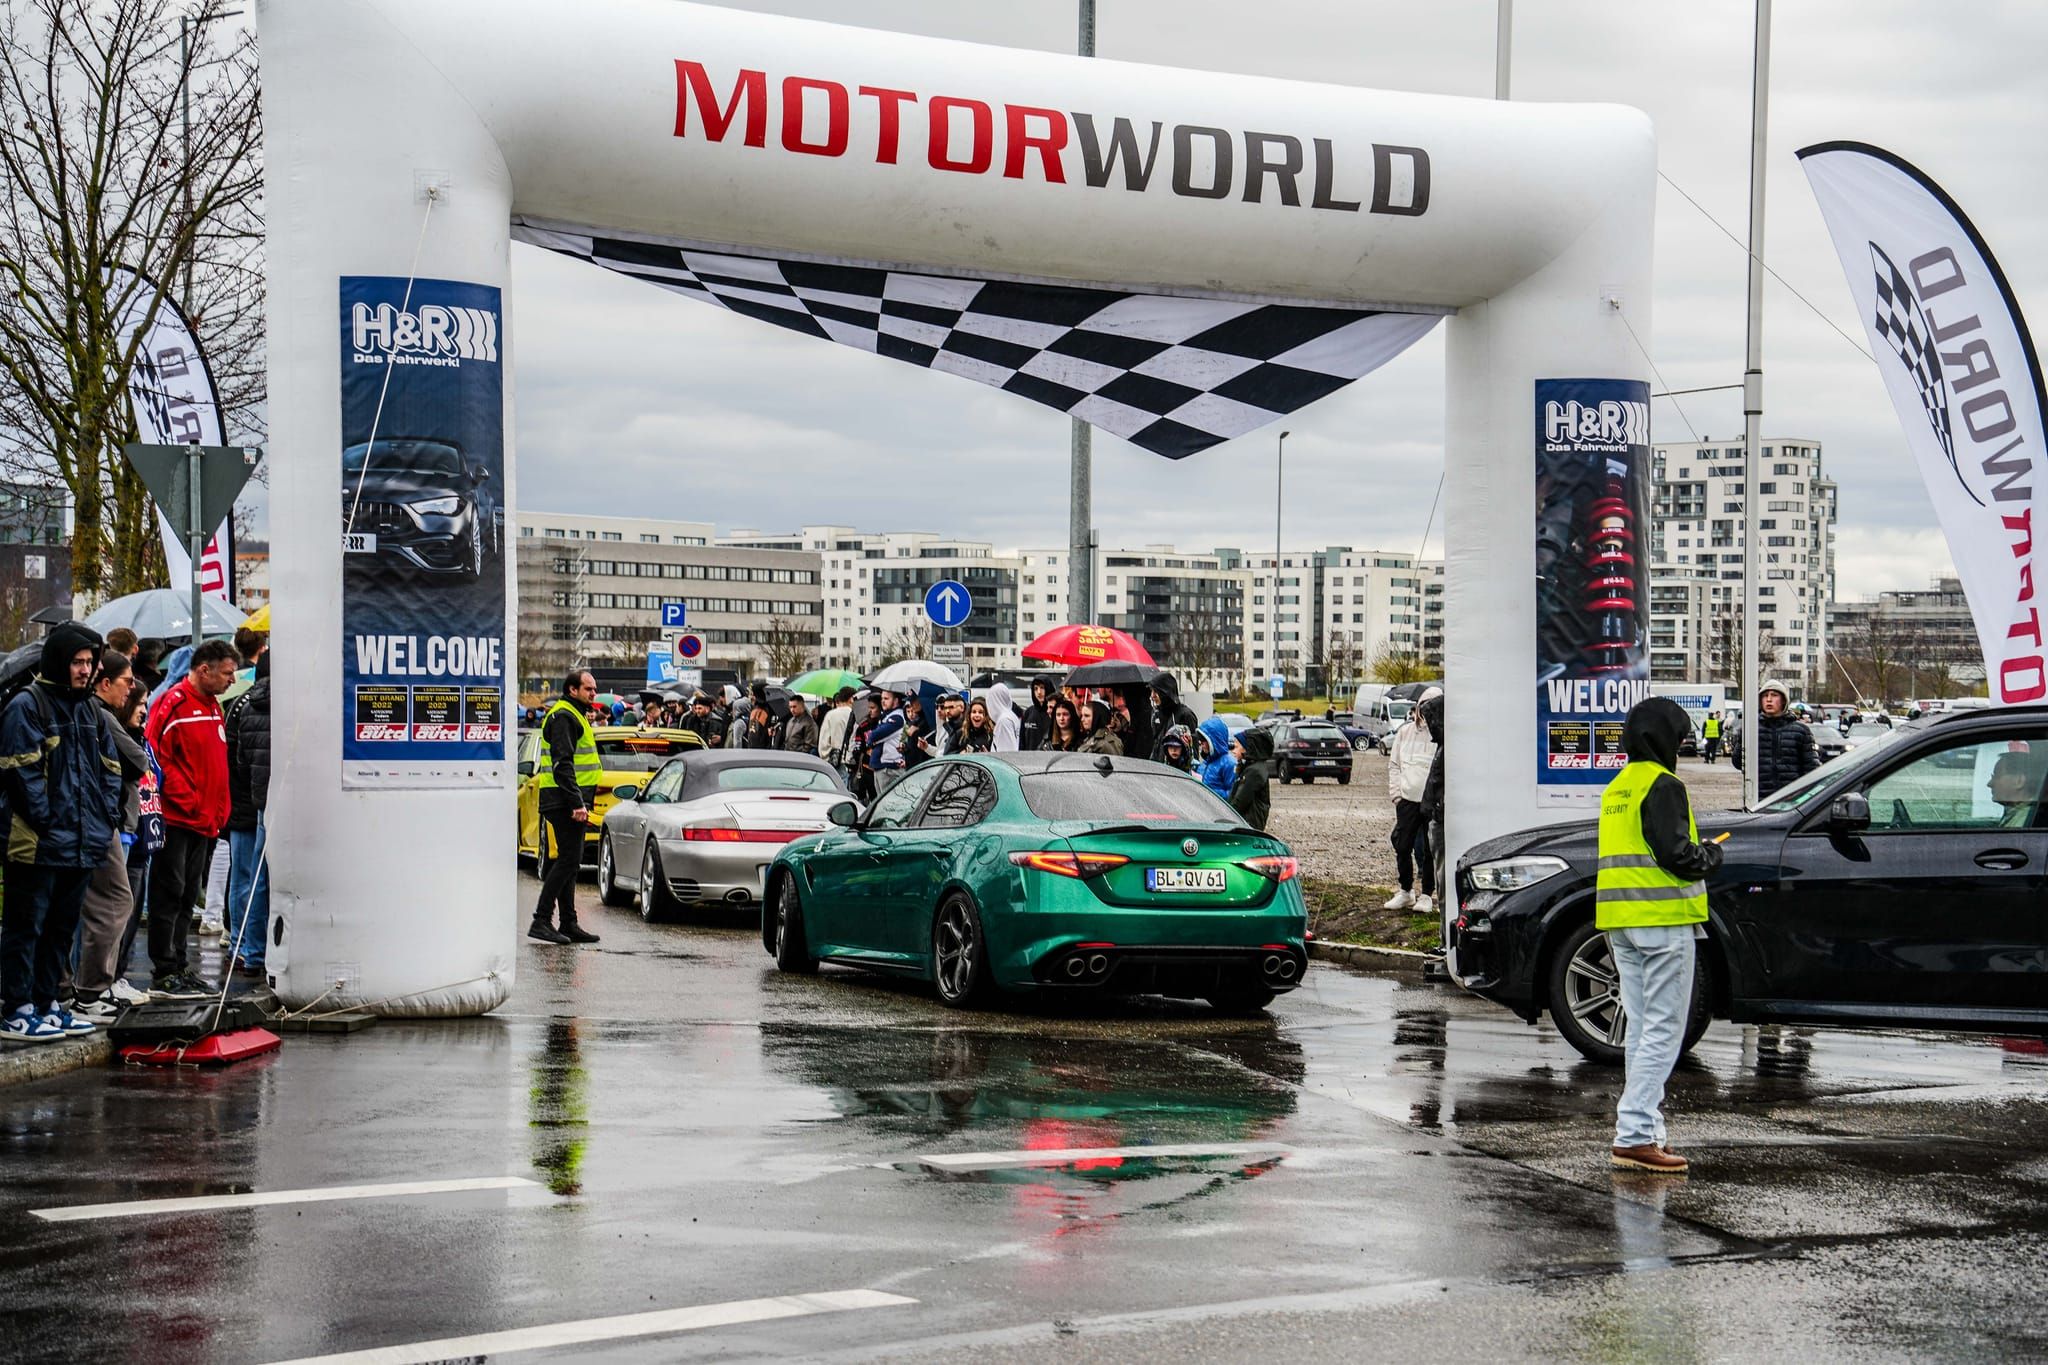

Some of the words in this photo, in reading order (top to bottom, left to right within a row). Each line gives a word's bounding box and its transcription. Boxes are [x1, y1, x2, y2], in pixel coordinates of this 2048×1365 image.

[673, 59, 1431, 217] MOTORWORLD
[354, 302, 458, 357] H&R
[353, 353, 383, 363] Das
[1545, 400, 1628, 444] H&R
[1545, 443, 1571, 452] Das
[667, 605, 681, 624] P
[1079, 625, 1112, 638] 20
[1078, 636, 1114, 645] Jahre
[355, 635, 501, 677] WELCOME
[359, 728, 408, 739] auto
[415, 728, 461, 739] auto
[467, 728, 500, 739] auto
[1550, 757, 1590, 767] auto
[1595, 757, 1628, 767] auto
[1603, 803, 1629, 815] SECURITY
[1156, 871, 1175, 887] BL
[1184, 871, 1203, 887] QV
[1206, 872, 1224, 887] 61
